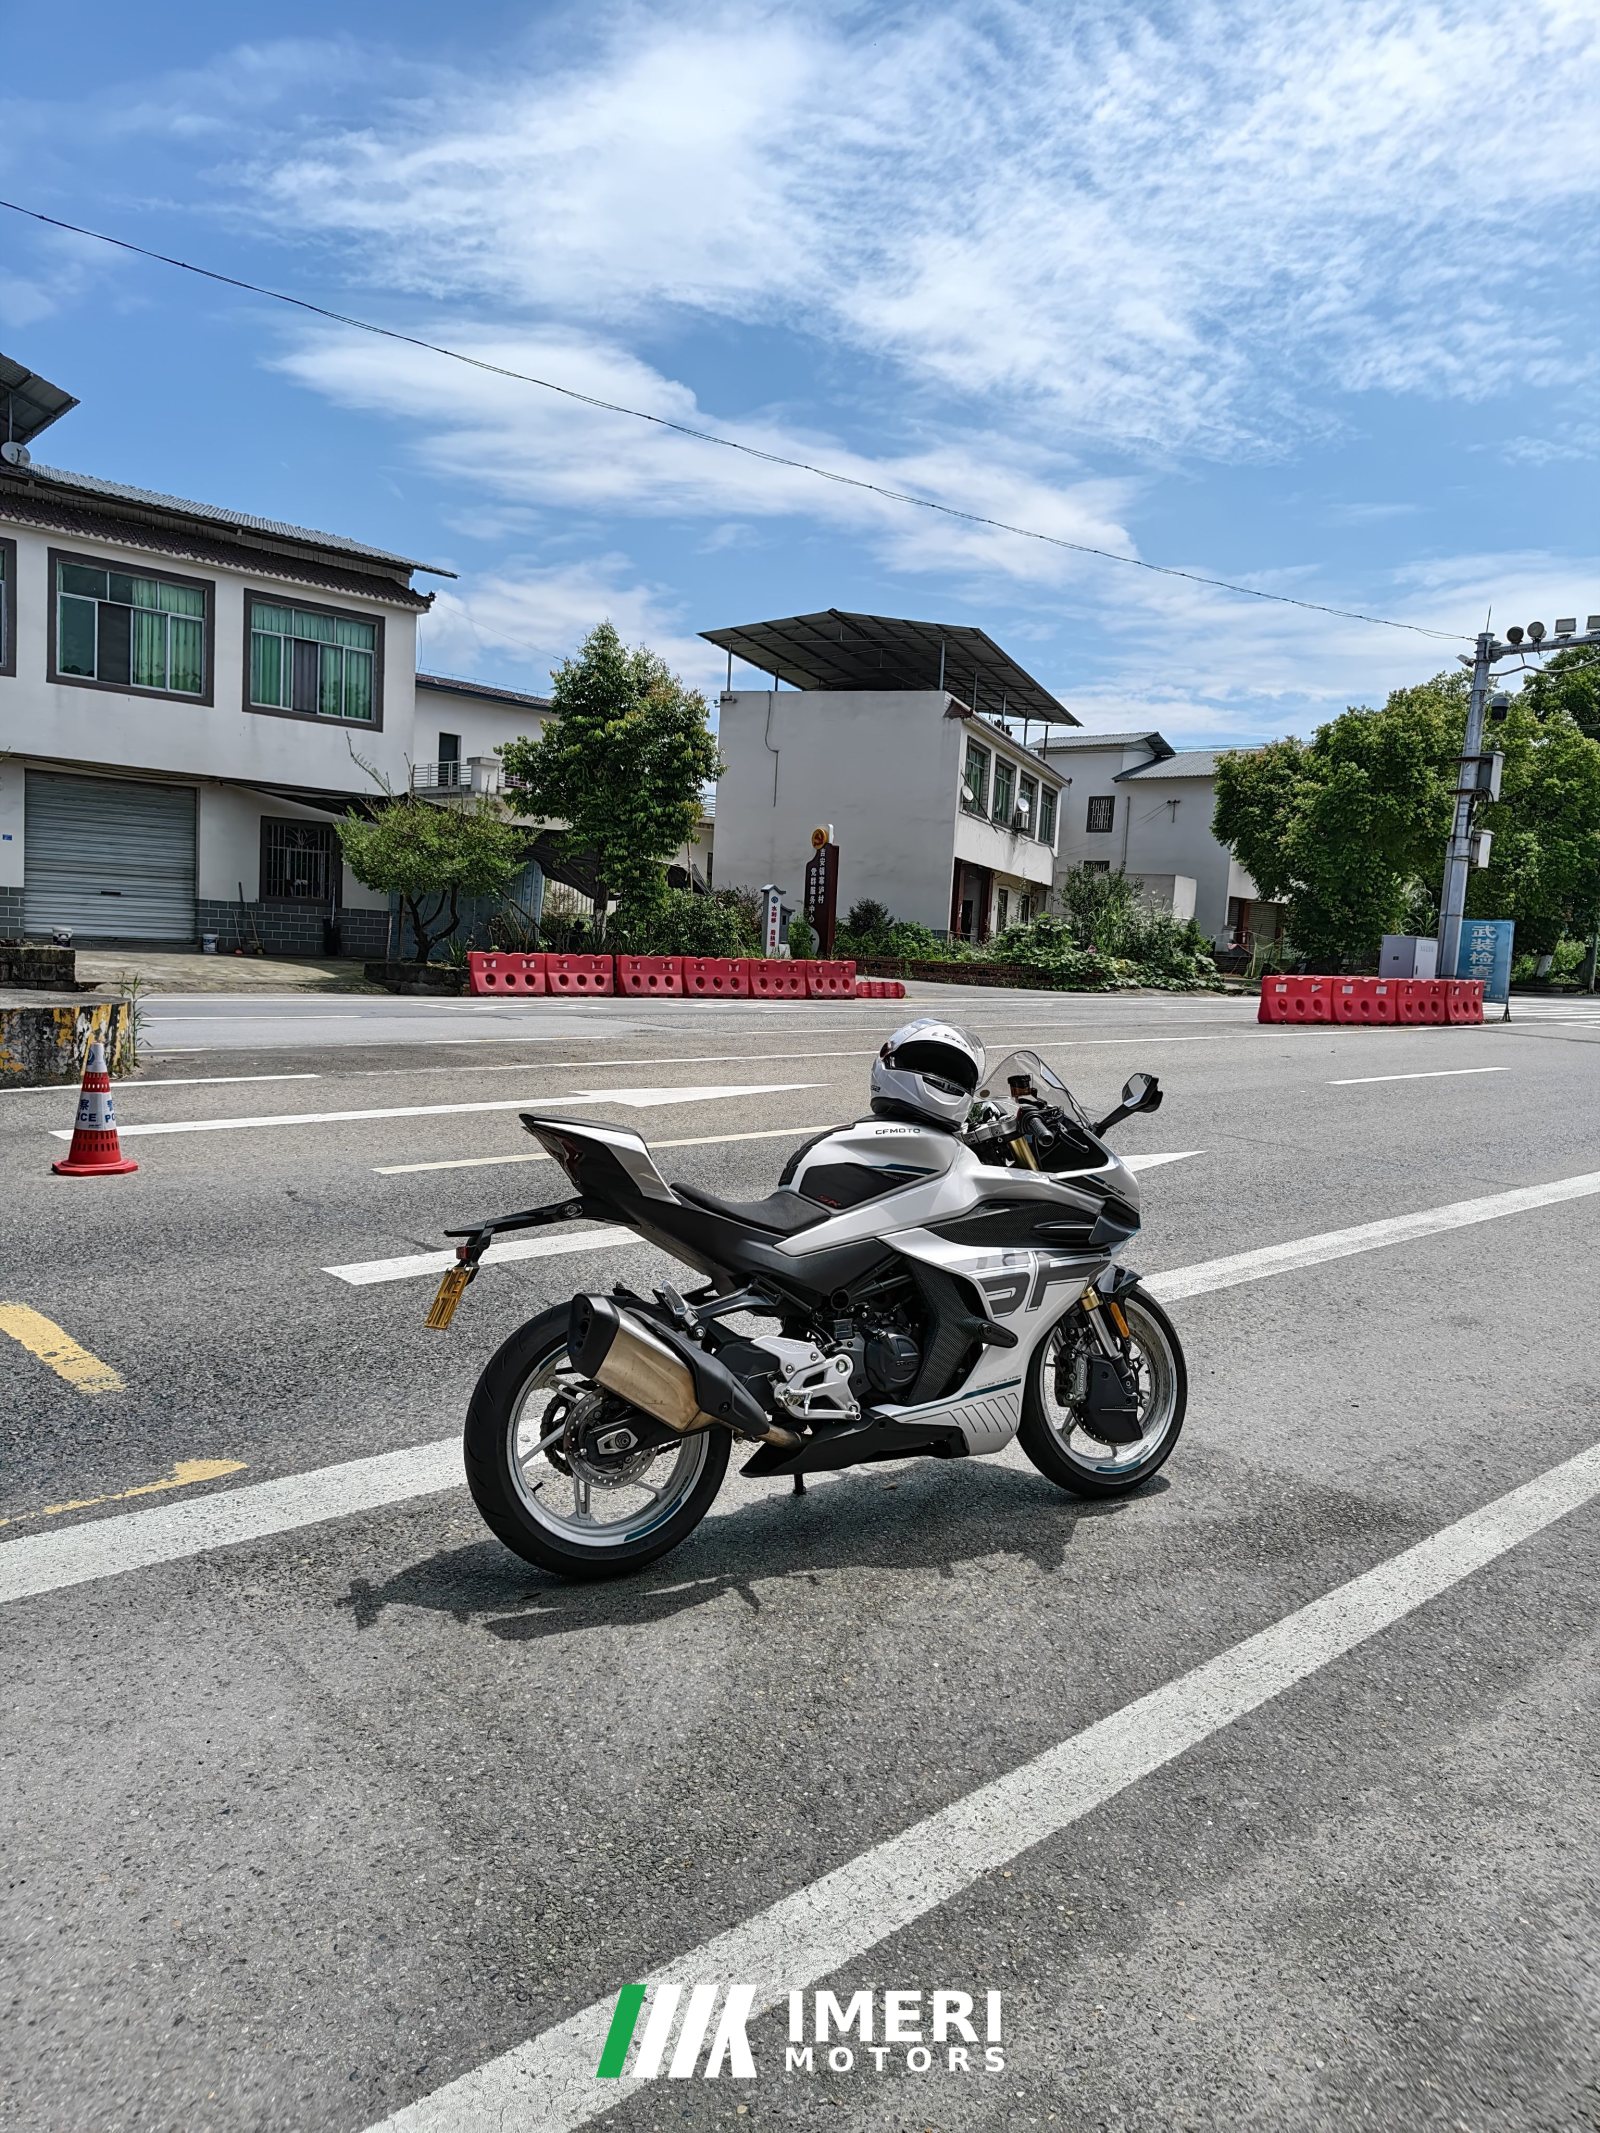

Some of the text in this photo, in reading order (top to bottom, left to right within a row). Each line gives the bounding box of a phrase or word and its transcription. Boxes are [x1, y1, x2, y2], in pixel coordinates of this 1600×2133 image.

[808, 867, 818, 923] 党群服务中心
